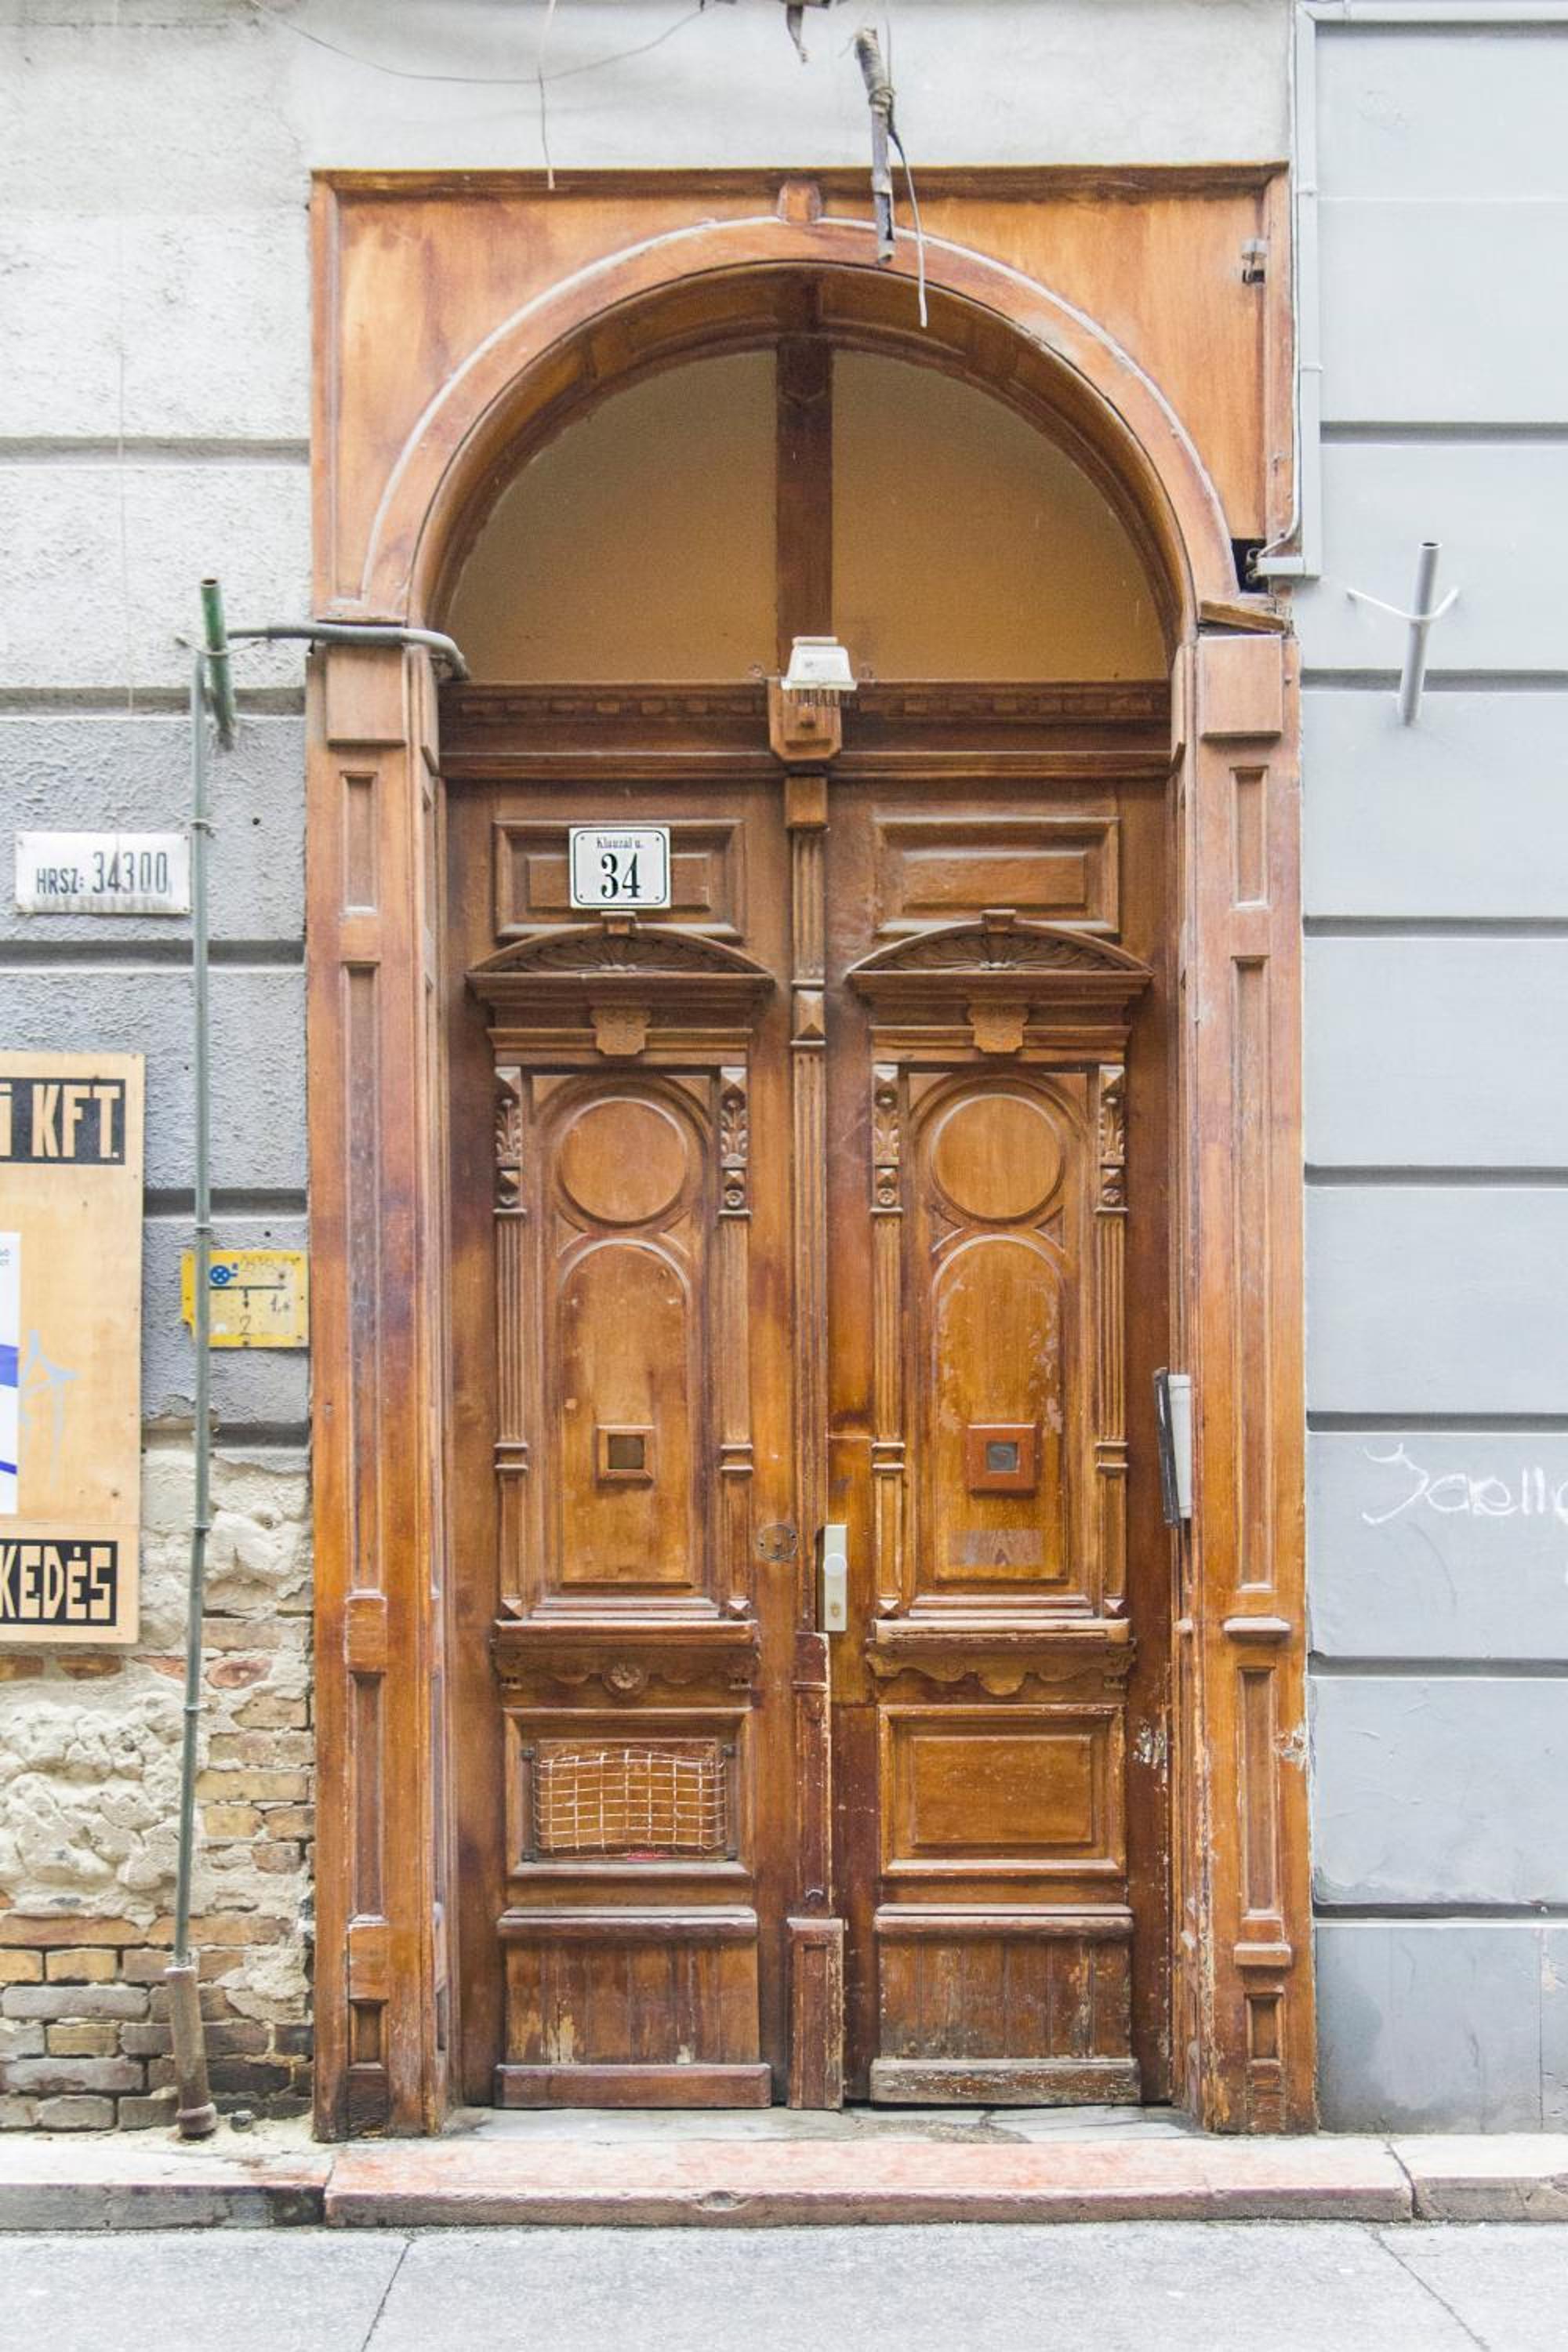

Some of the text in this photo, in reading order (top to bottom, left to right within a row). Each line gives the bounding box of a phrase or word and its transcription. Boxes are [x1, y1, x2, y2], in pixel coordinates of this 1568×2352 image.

[37, 851, 167, 895] HRSZ: 34300
[601, 852, 641, 899] 34
[32, 1084, 120, 1158] KFT.
